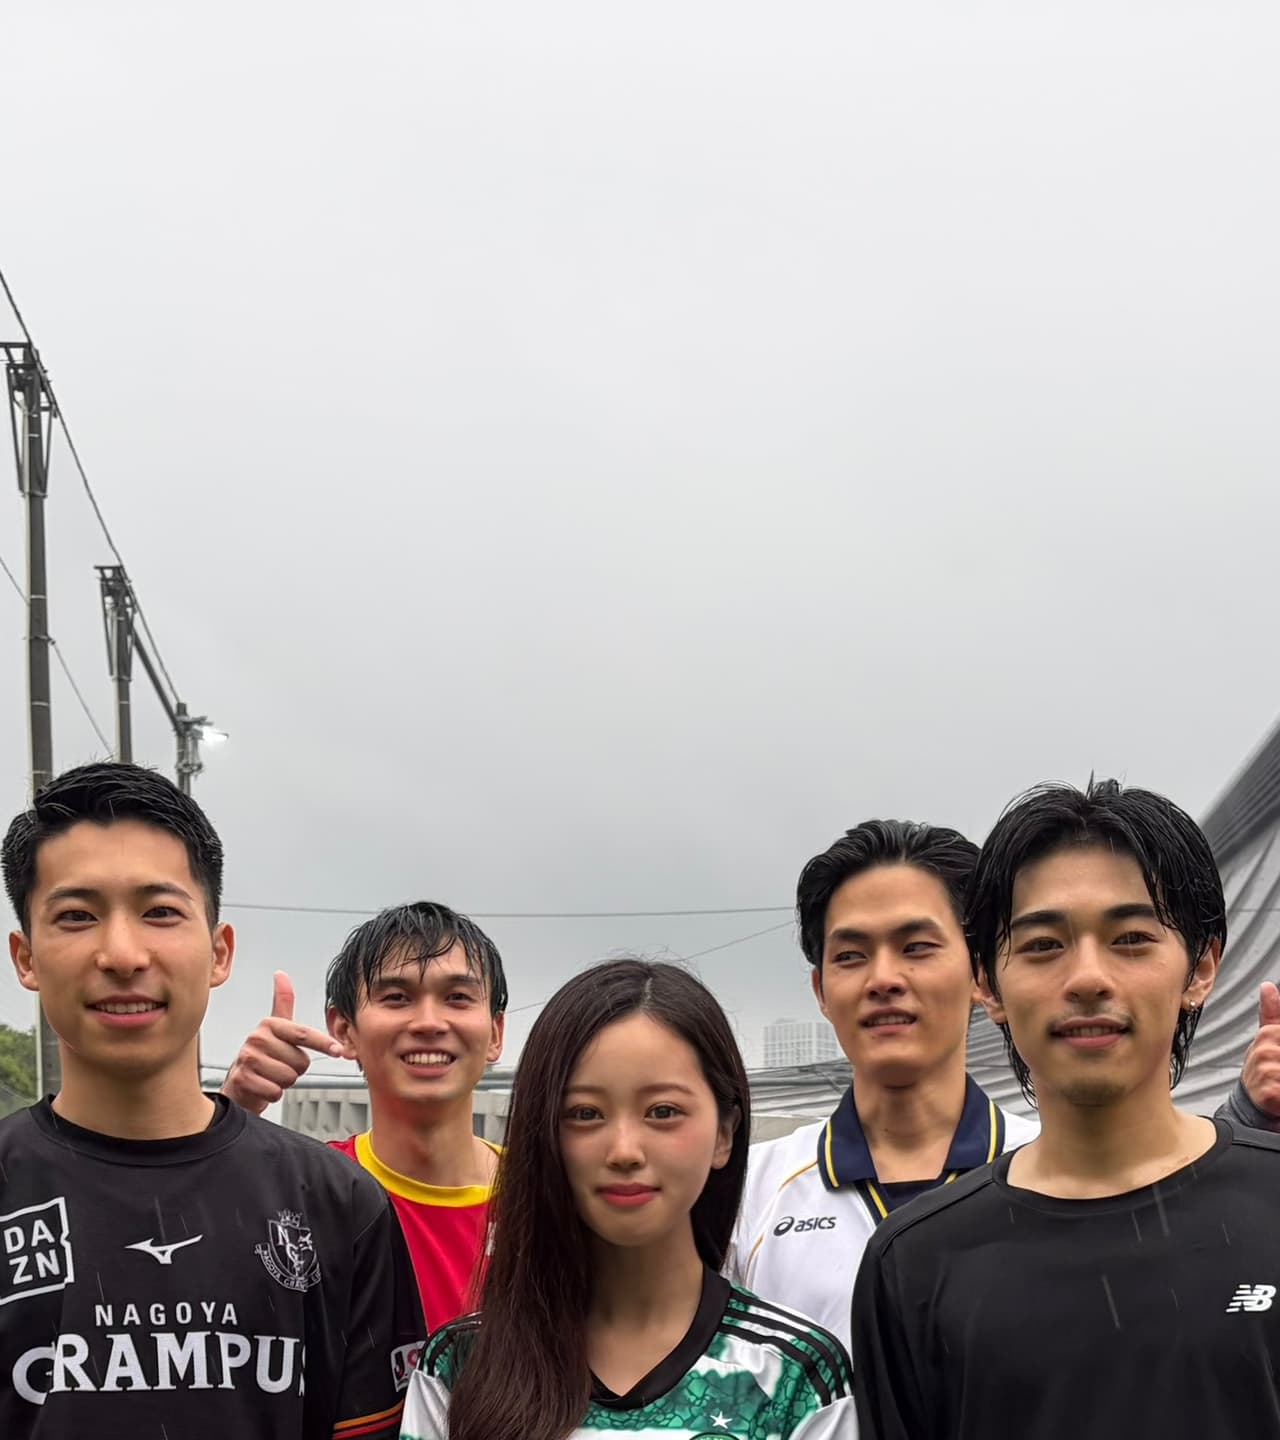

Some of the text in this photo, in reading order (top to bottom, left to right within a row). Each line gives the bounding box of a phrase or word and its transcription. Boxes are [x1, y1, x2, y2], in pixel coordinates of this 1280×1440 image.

[3, 1219, 56, 1254] DA
[794, 1216, 837, 1233] asics
[8, 1248, 61, 1285] ZN
[95, 1301, 238, 1327] NAGOYA
[12, 1331, 306, 1405] GRAMPU
